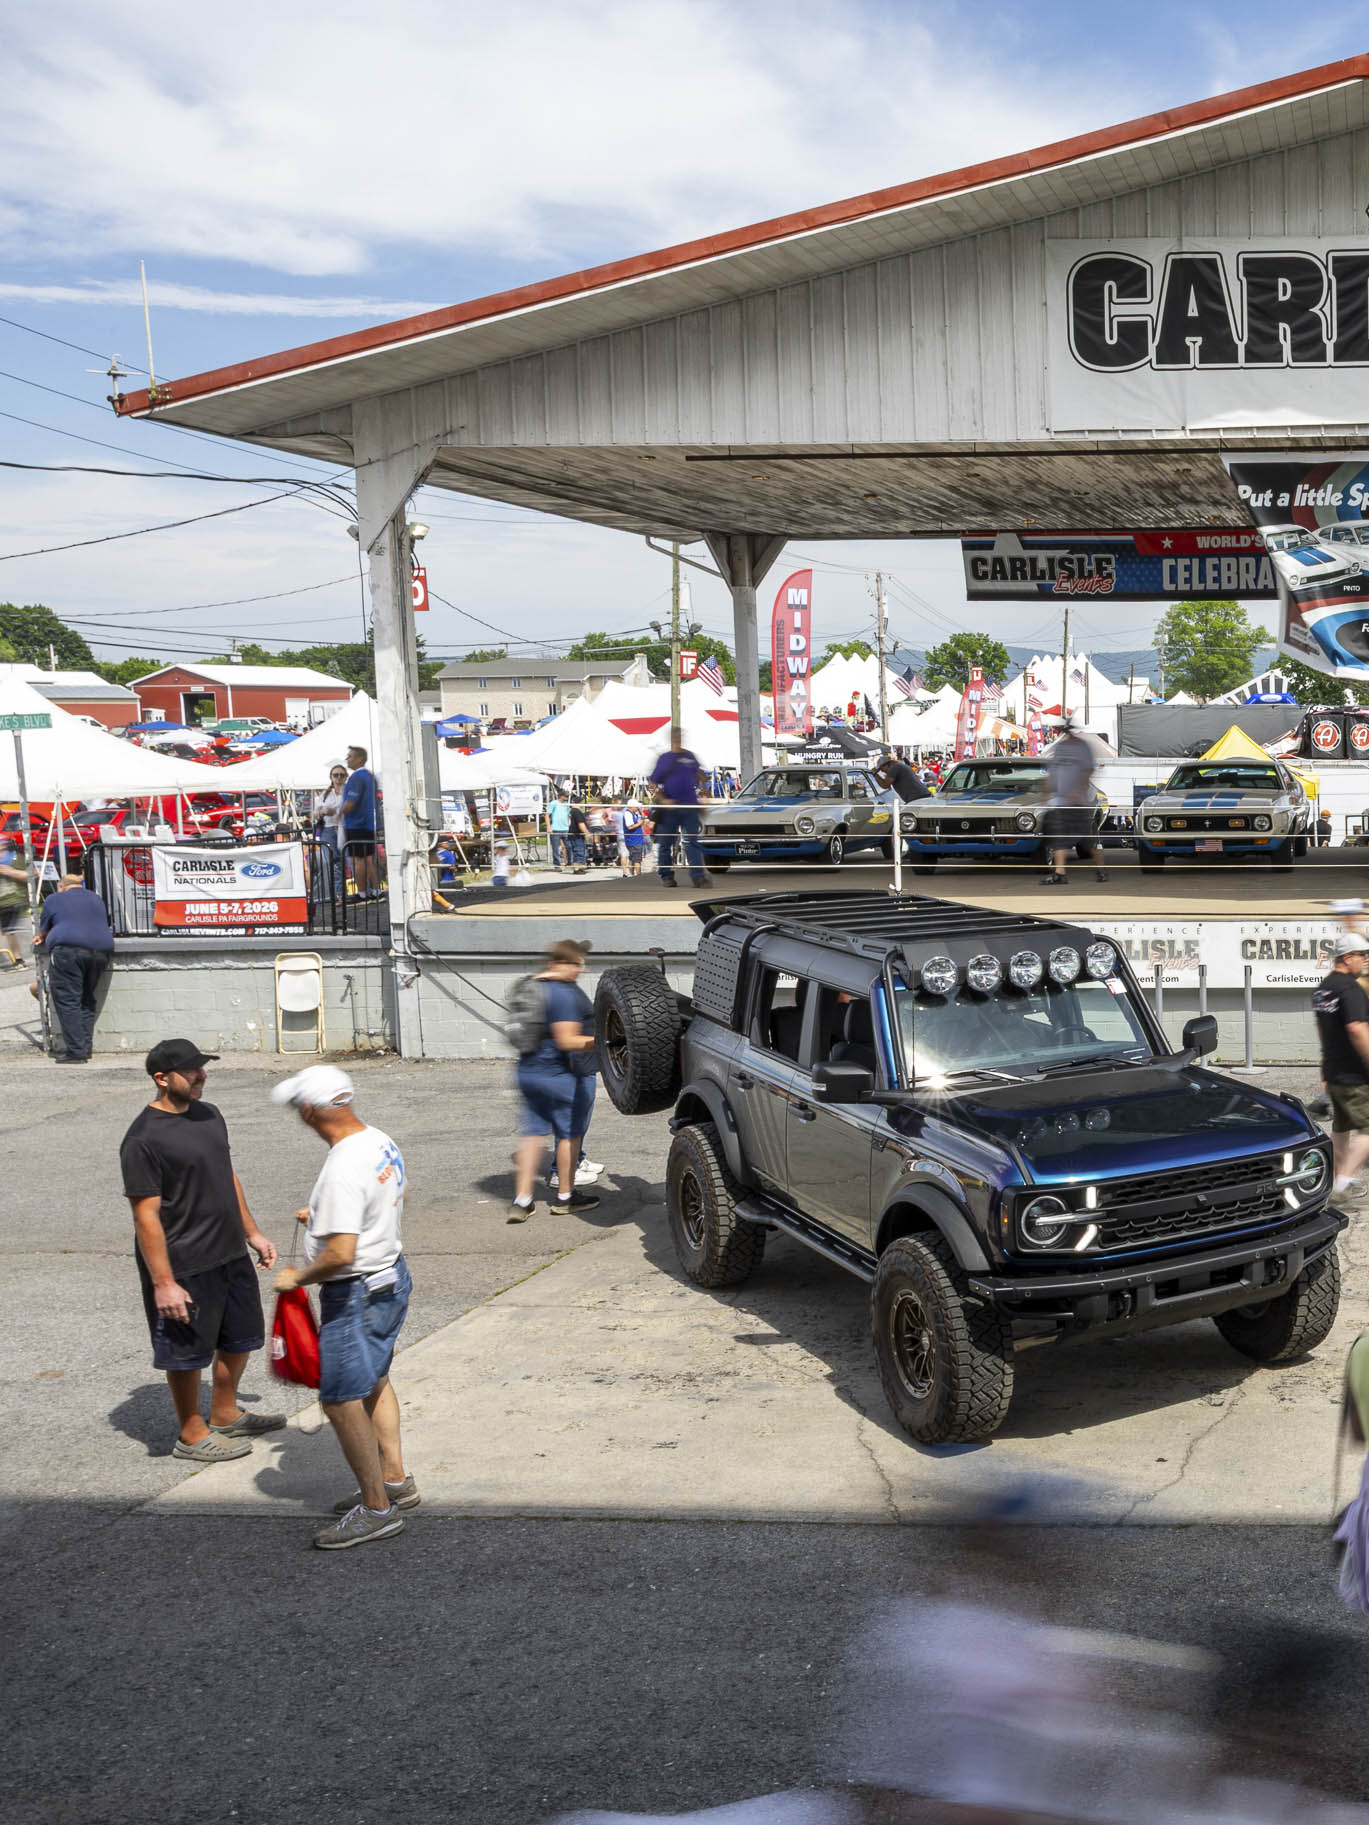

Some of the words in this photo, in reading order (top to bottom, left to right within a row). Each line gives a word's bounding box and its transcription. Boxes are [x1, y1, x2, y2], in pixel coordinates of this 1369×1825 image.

[1238, 485, 1272, 507] Put
[1276, 492, 1289, 507] a
[1293, 484, 1344, 507] little
[1196, 535, 1265, 549] WORLD'S
[970, 554, 1114, 581] CARLISLE
[1053, 572, 1114, 594] Events
[786, 588, 809, 722] MIDWAY
[23, 715, 47, 728] BLVD
[173, 860, 235, 872] CARLISLE
[248, 865, 275, 876] Ford
[173, 876, 237, 885] NATIONALS
[185, 903, 219, 915] JUNE
[220, 903, 242, 914] 5-7,
[243, 902, 278, 913] 2026
[229, 914, 278, 922] FAIRGROUNDS
[1099, 927, 1201, 935] PERIENCE
[1119, 938, 1201, 960] LISLE
[1241, 939, 1336, 960] CARLIS
[1148, 952, 1201, 971] Events
[1266, 974, 1325, 983] CarlisleEvent
